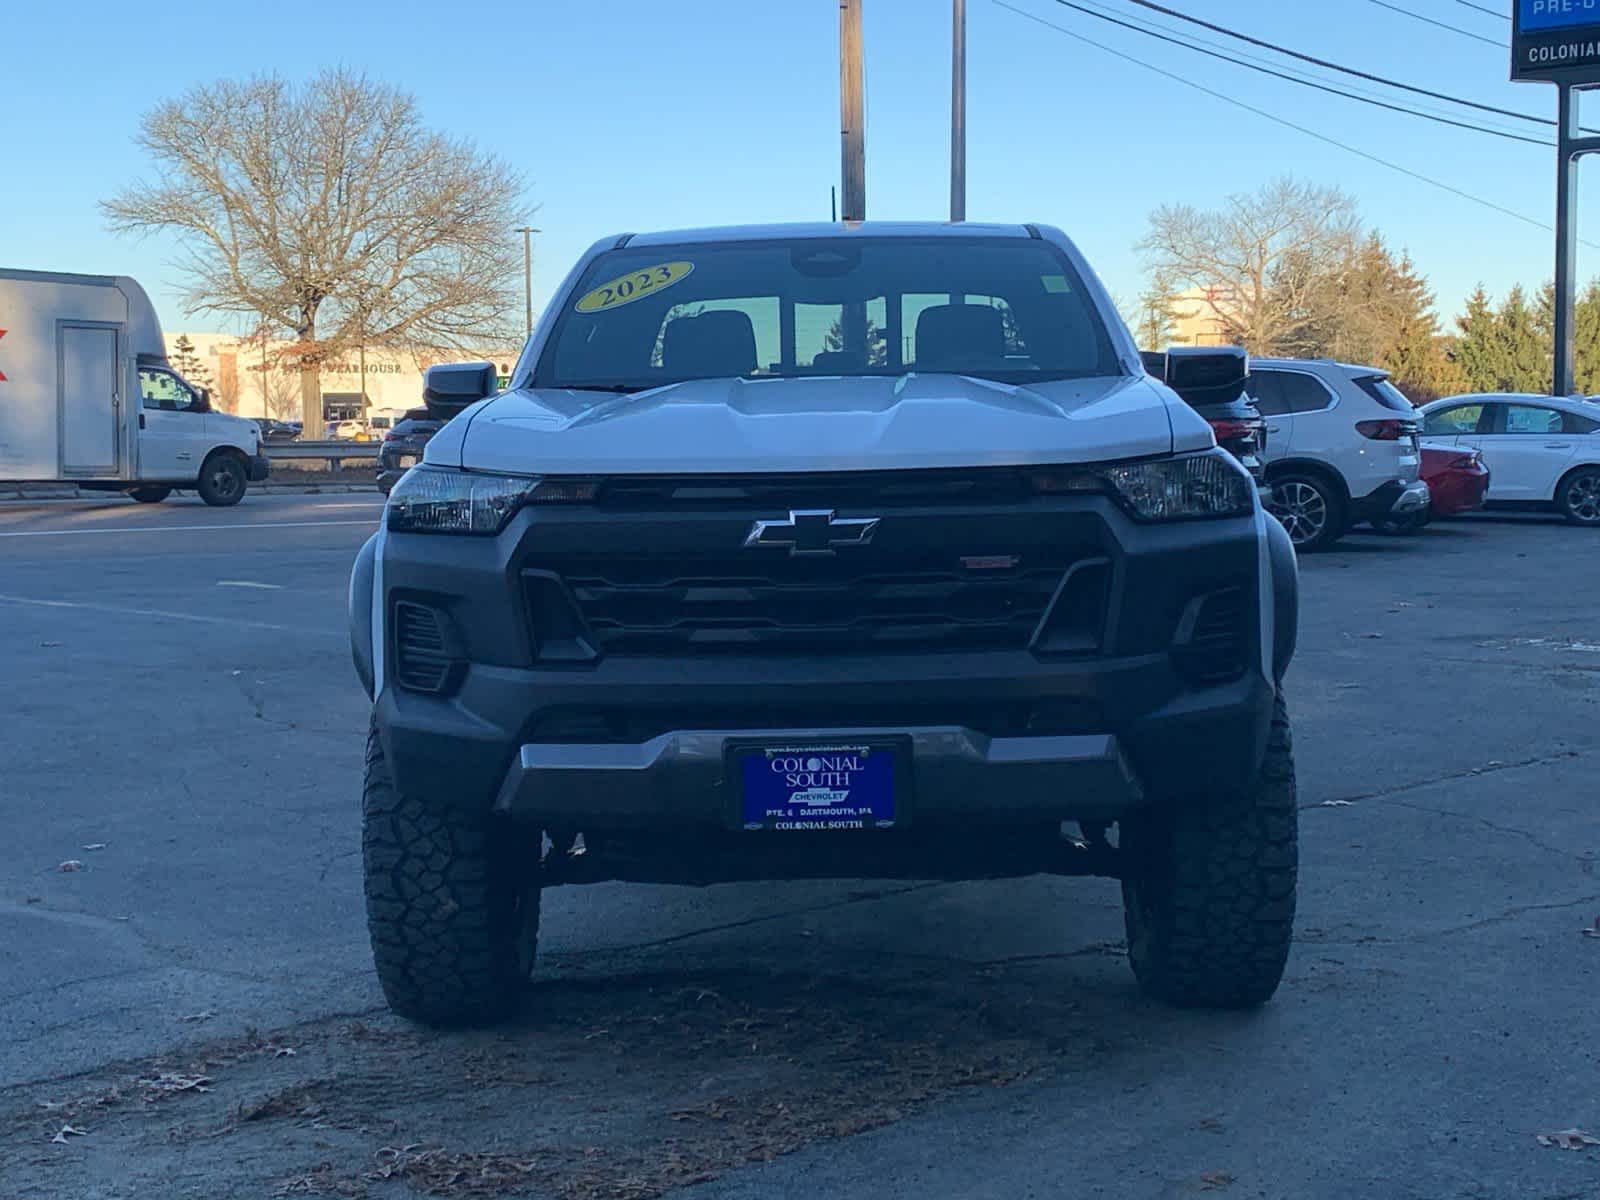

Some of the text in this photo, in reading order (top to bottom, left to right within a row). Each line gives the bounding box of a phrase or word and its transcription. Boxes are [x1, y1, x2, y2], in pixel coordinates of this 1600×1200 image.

[598, 266, 672, 306] 2023
[771, 756, 865, 773] COLONIAL
[786, 772, 850, 787] SOUTH
[794, 791, 844, 801] CHEVROLET
[776, 819, 864, 830] COLONIAL SOUTH
